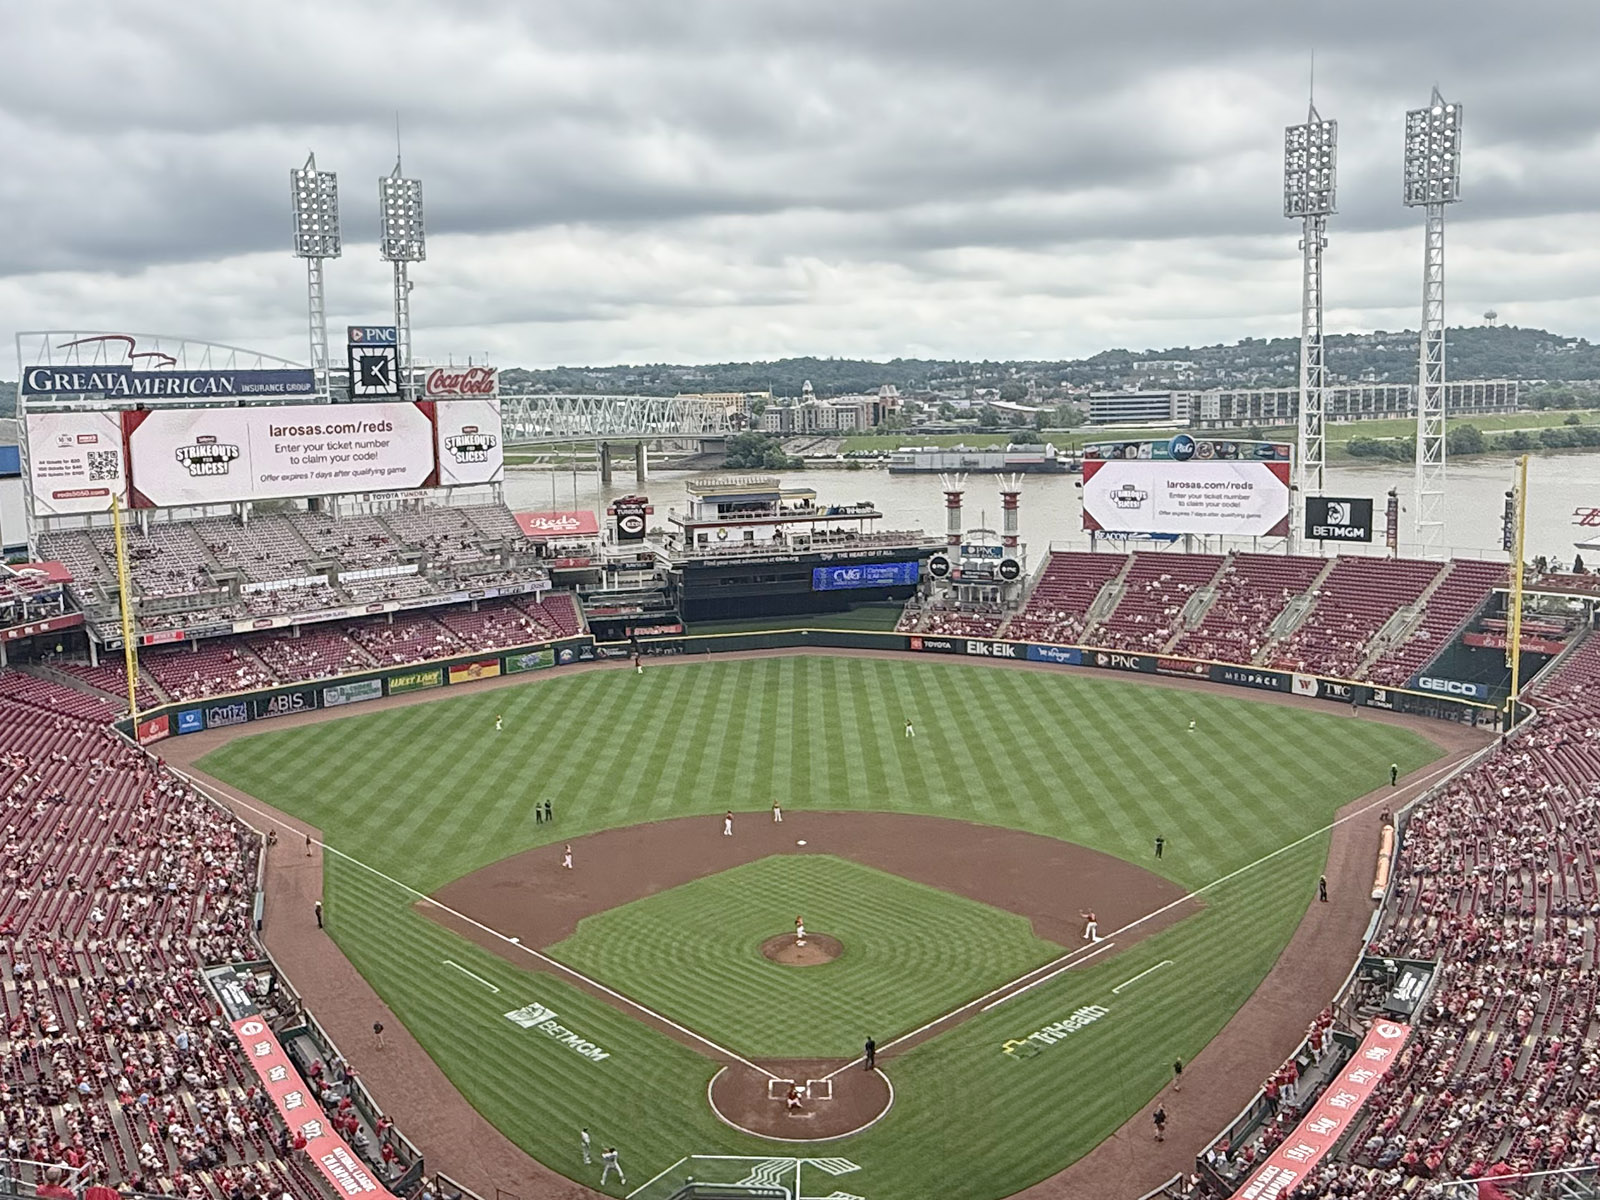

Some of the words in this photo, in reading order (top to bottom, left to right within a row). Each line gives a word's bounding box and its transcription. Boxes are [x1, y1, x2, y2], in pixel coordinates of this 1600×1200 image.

[365, 328, 395, 341] PNC
[28, 369, 117, 391] GREAT
[110, 374, 235, 396] AMERICAN
[241, 383, 284, 393] INSURANCE
[286, 383, 311, 392] GROUP
[426, 367, 498, 395] Coca-Cola
[269, 420, 393, 437] larosas.com/reds
[275, 443, 300, 454] Enter
[303, 442, 324, 454] your
[327, 441, 352, 450] ticket
[355, 439, 390, 449] number
[445, 434, 496, 449] STRIKEOUTS
[1174, 443, 1193, 453] P&G
[176, 444, 239, 461] STRIKEOUTS
[290, 456, 300, 465] to
[302, 453, 327, 464] claim
[330, 453, 350, 465] your
[353, 451, 378, 461] code!
[189, 461, 229, 476] SLICES!
[260, 473, 280, 483] Offer
[316, 471, 332, 480] days
[1167, 480, 1254, 490] larosas.com/reds
[400, 490, 428, 498] TUNDRA
[530, 515, 580, 530] Reds
[1094, 530, 1127, 541] BEACON
[1312, 525, 1365, 538] BETMGM
[833, 568, 860, 580] CVG
[924, 641, 951, 649] TOYOTA
[1111, 654, 1140, 669] PNC
[1224, 672, 1278, 686] MEDPACE
[1298, 679, 1311, 690] W
[1418, 676, 1477, 696] GEICO
[1324, 682, 1351, 697] TWC
[1027, 1004, 1110, 1045] TriHealth
[538, 1020, 611, 1062] BETMGM
[320, 1153, 363, 1195] CHAMPIONS
